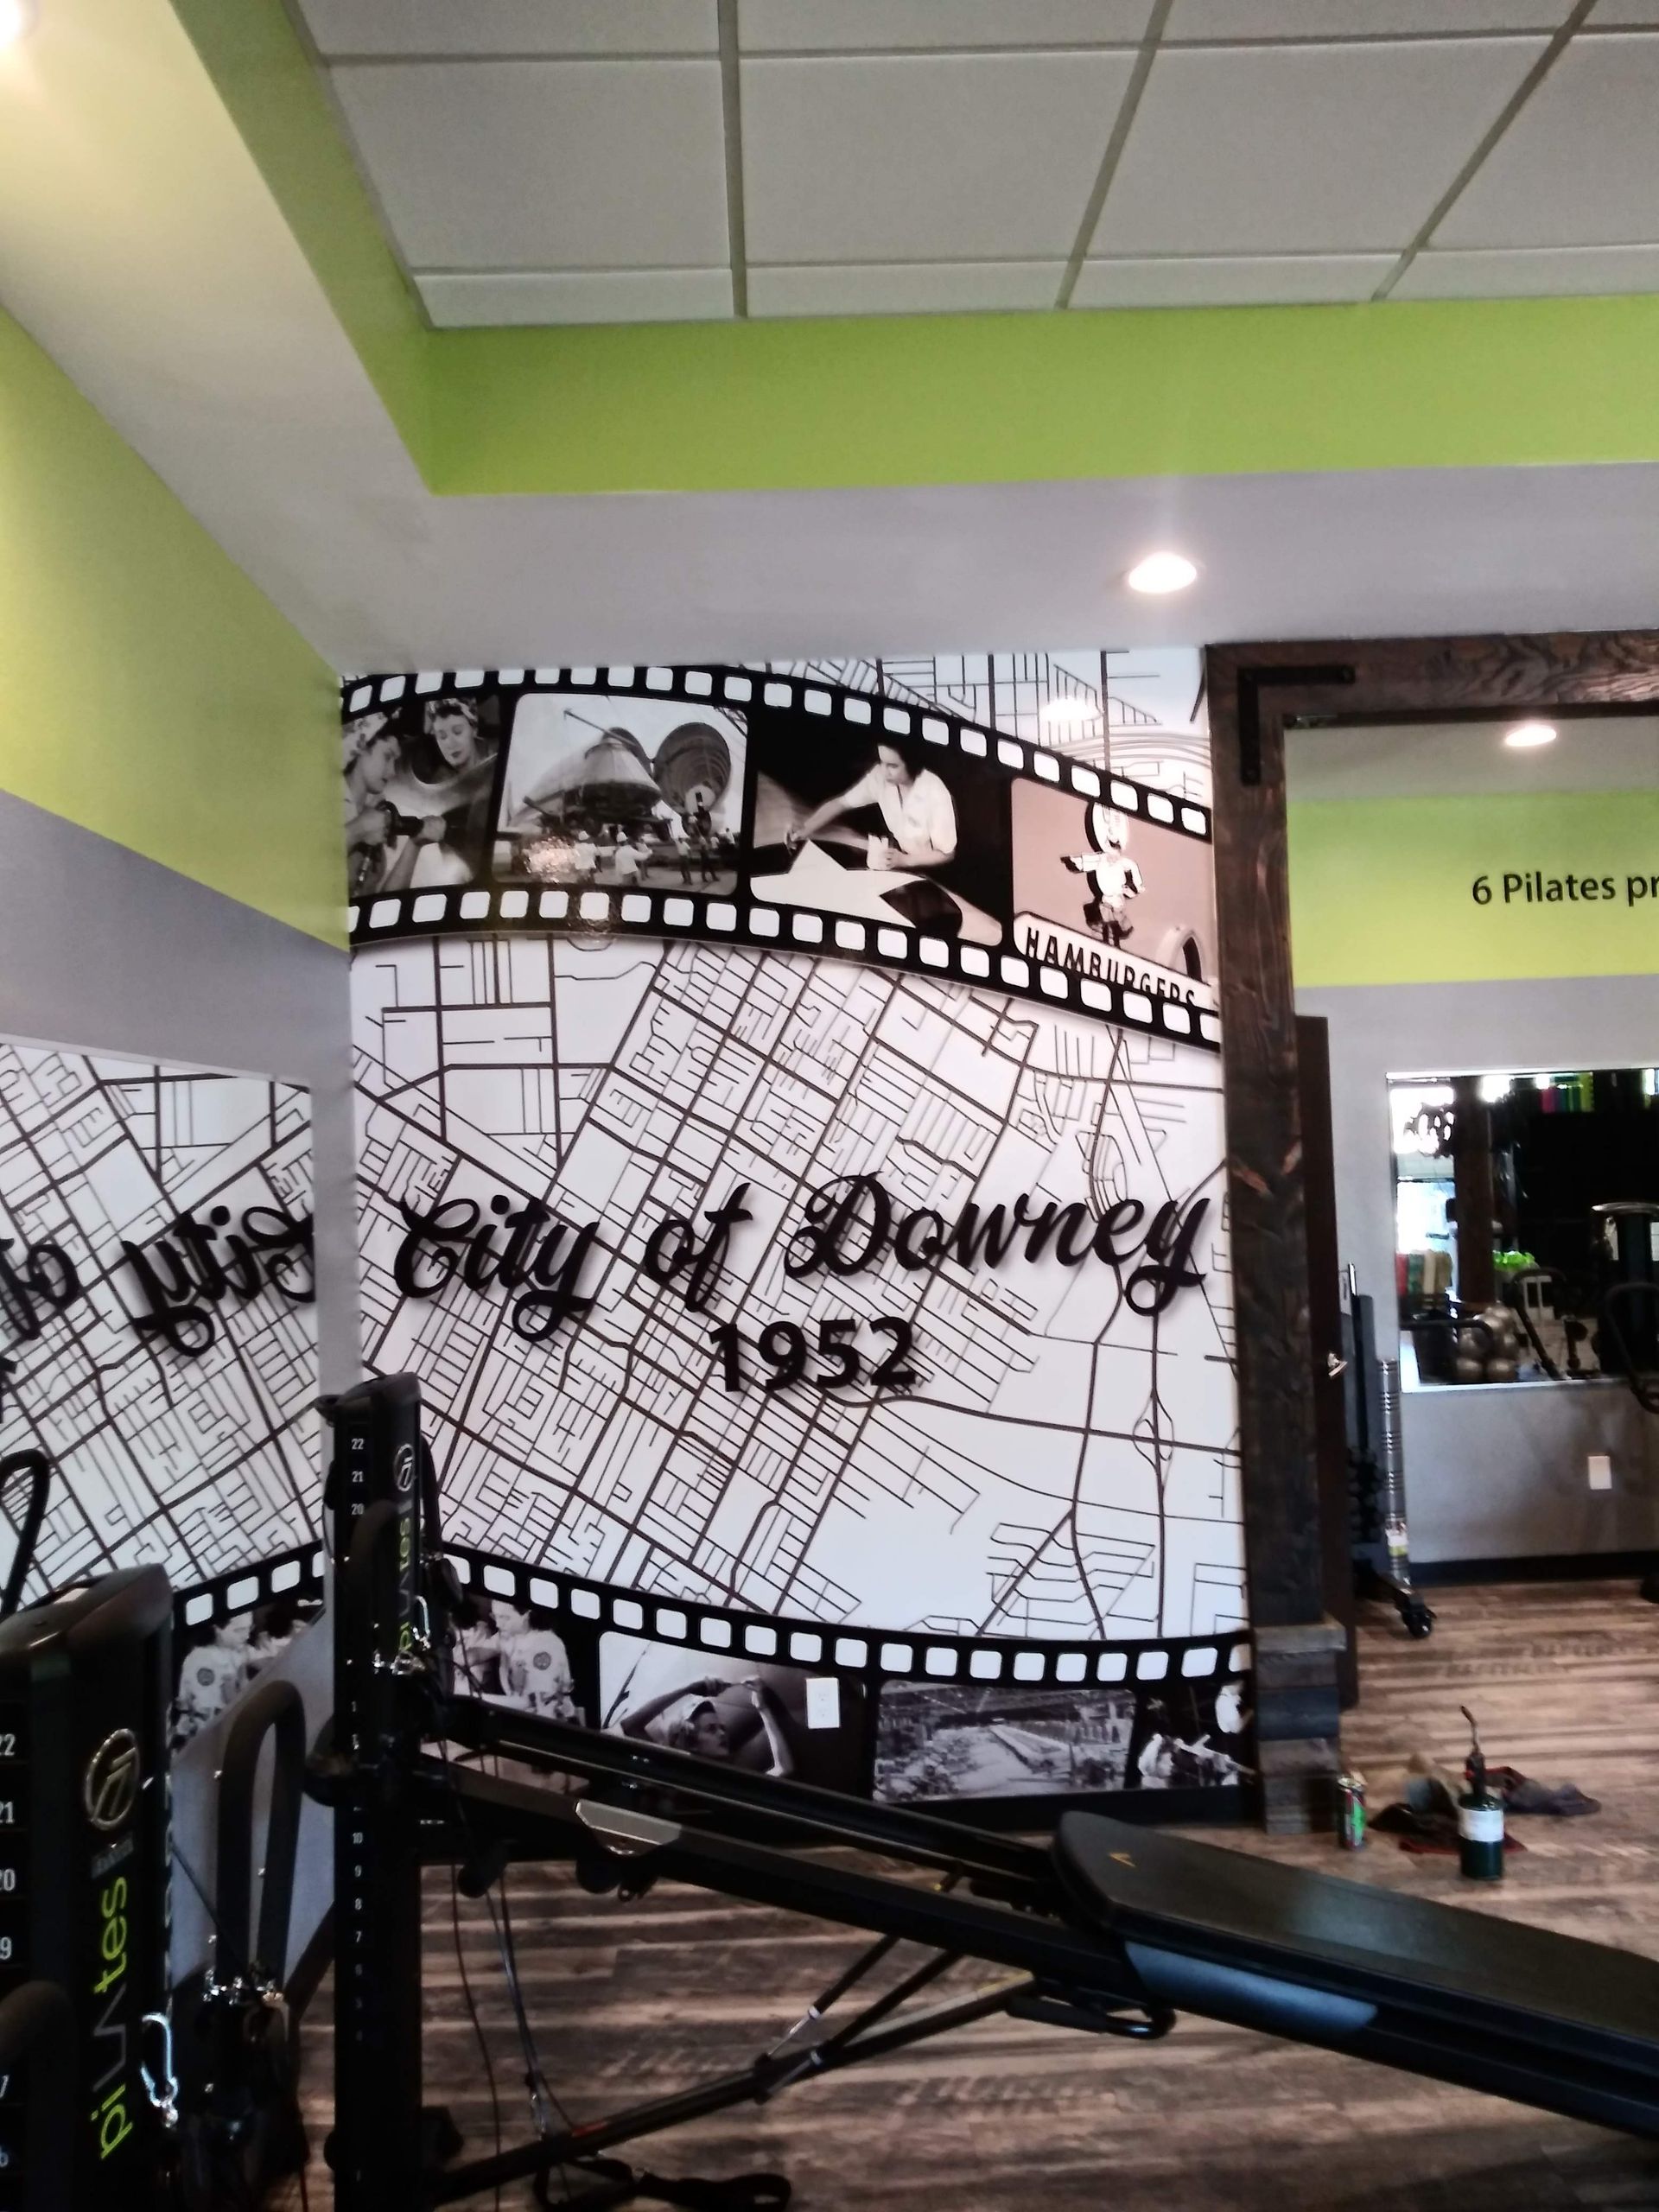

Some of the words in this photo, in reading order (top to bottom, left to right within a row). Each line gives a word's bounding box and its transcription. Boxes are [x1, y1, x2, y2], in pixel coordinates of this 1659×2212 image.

[1472, 875, 1492, 905] 6
[1503, 871, 1616, 904] Pilates
[394, 1195, 599, 1342] City
[645, 1183, 753, 1312] of
[784, 1172, 1210, 1316] Downey
[709, 1316, 917, 1393] 1952
[351, 1438, 364, 1450] 22
[352, 1471, 364, 1483] 21
